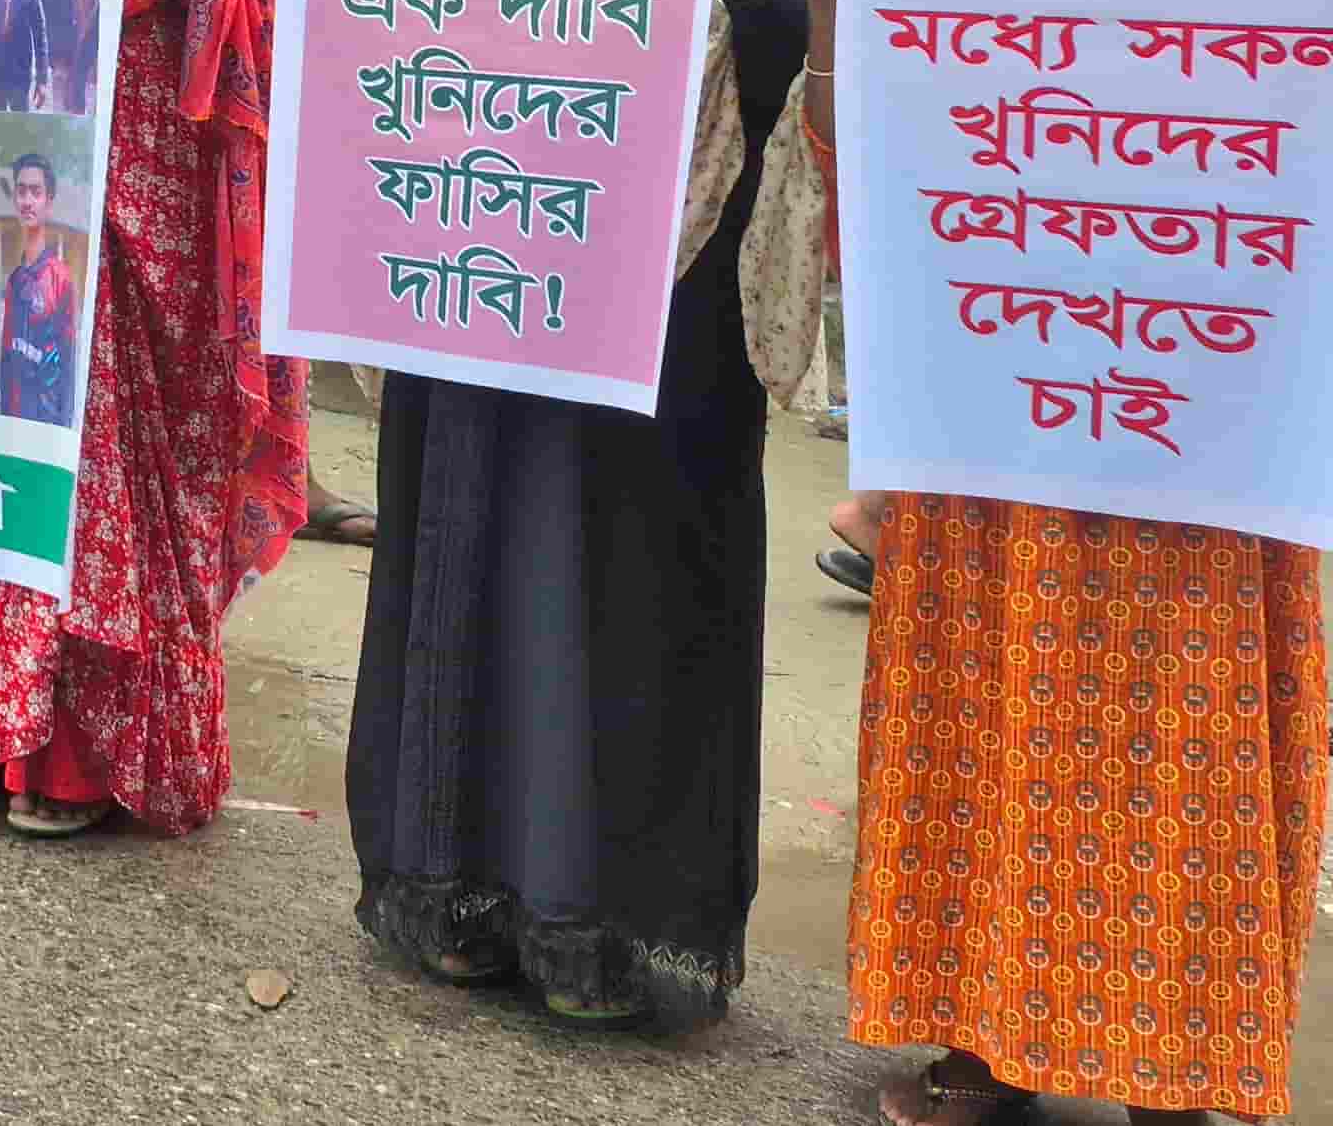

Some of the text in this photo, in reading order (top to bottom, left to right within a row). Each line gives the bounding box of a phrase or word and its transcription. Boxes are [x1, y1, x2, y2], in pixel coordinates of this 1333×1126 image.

[873, 7, 1098, 71] মধ্যে
[356, 46, 636, 147] খুনিদের
[947, 87, 1300, 178] খুনিদের
[365, 146, 606, 244] ফাসির
[916, 185, 1315, 274] গ্রেফতার
[947, 278, 1276, 355] দেখতে
[1014, 367, 1193, 457] চাই
